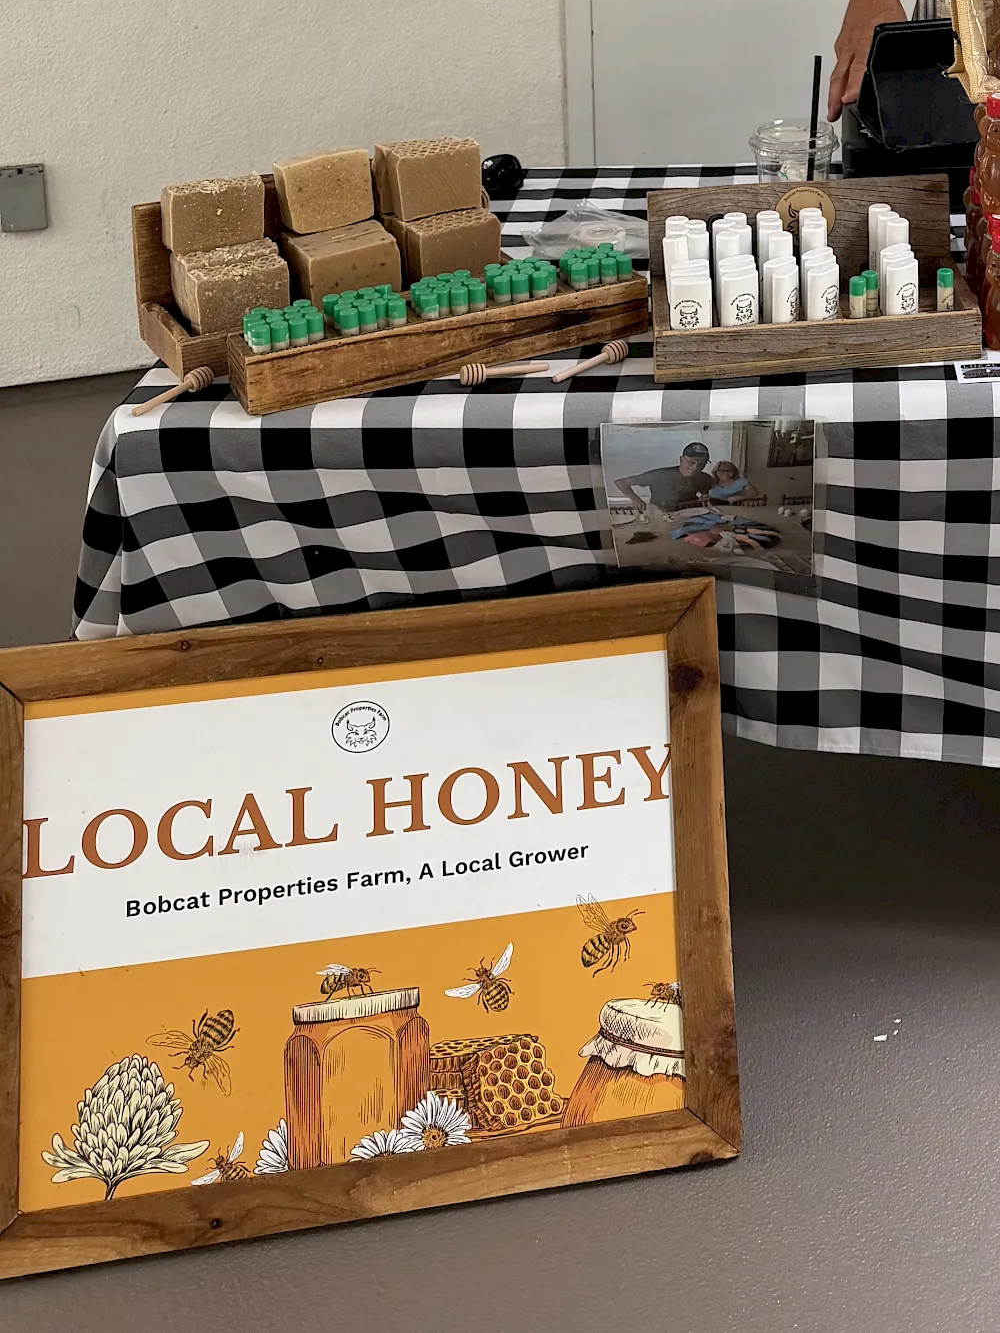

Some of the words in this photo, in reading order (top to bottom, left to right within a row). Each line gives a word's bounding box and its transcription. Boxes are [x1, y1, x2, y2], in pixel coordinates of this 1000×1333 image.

[22, 786, 339, 879] LOCAL
[365, 743, 672, 838] HONEY
[125, 890, 211, 918] Bobcat
[218, 876, 339, 906] Properties
[346, 869, 412, 890] Farm,
[418, 862, 434, 880] A
[441, 852, 502, 878] Local
[508, 843, 589, 868] Grower
